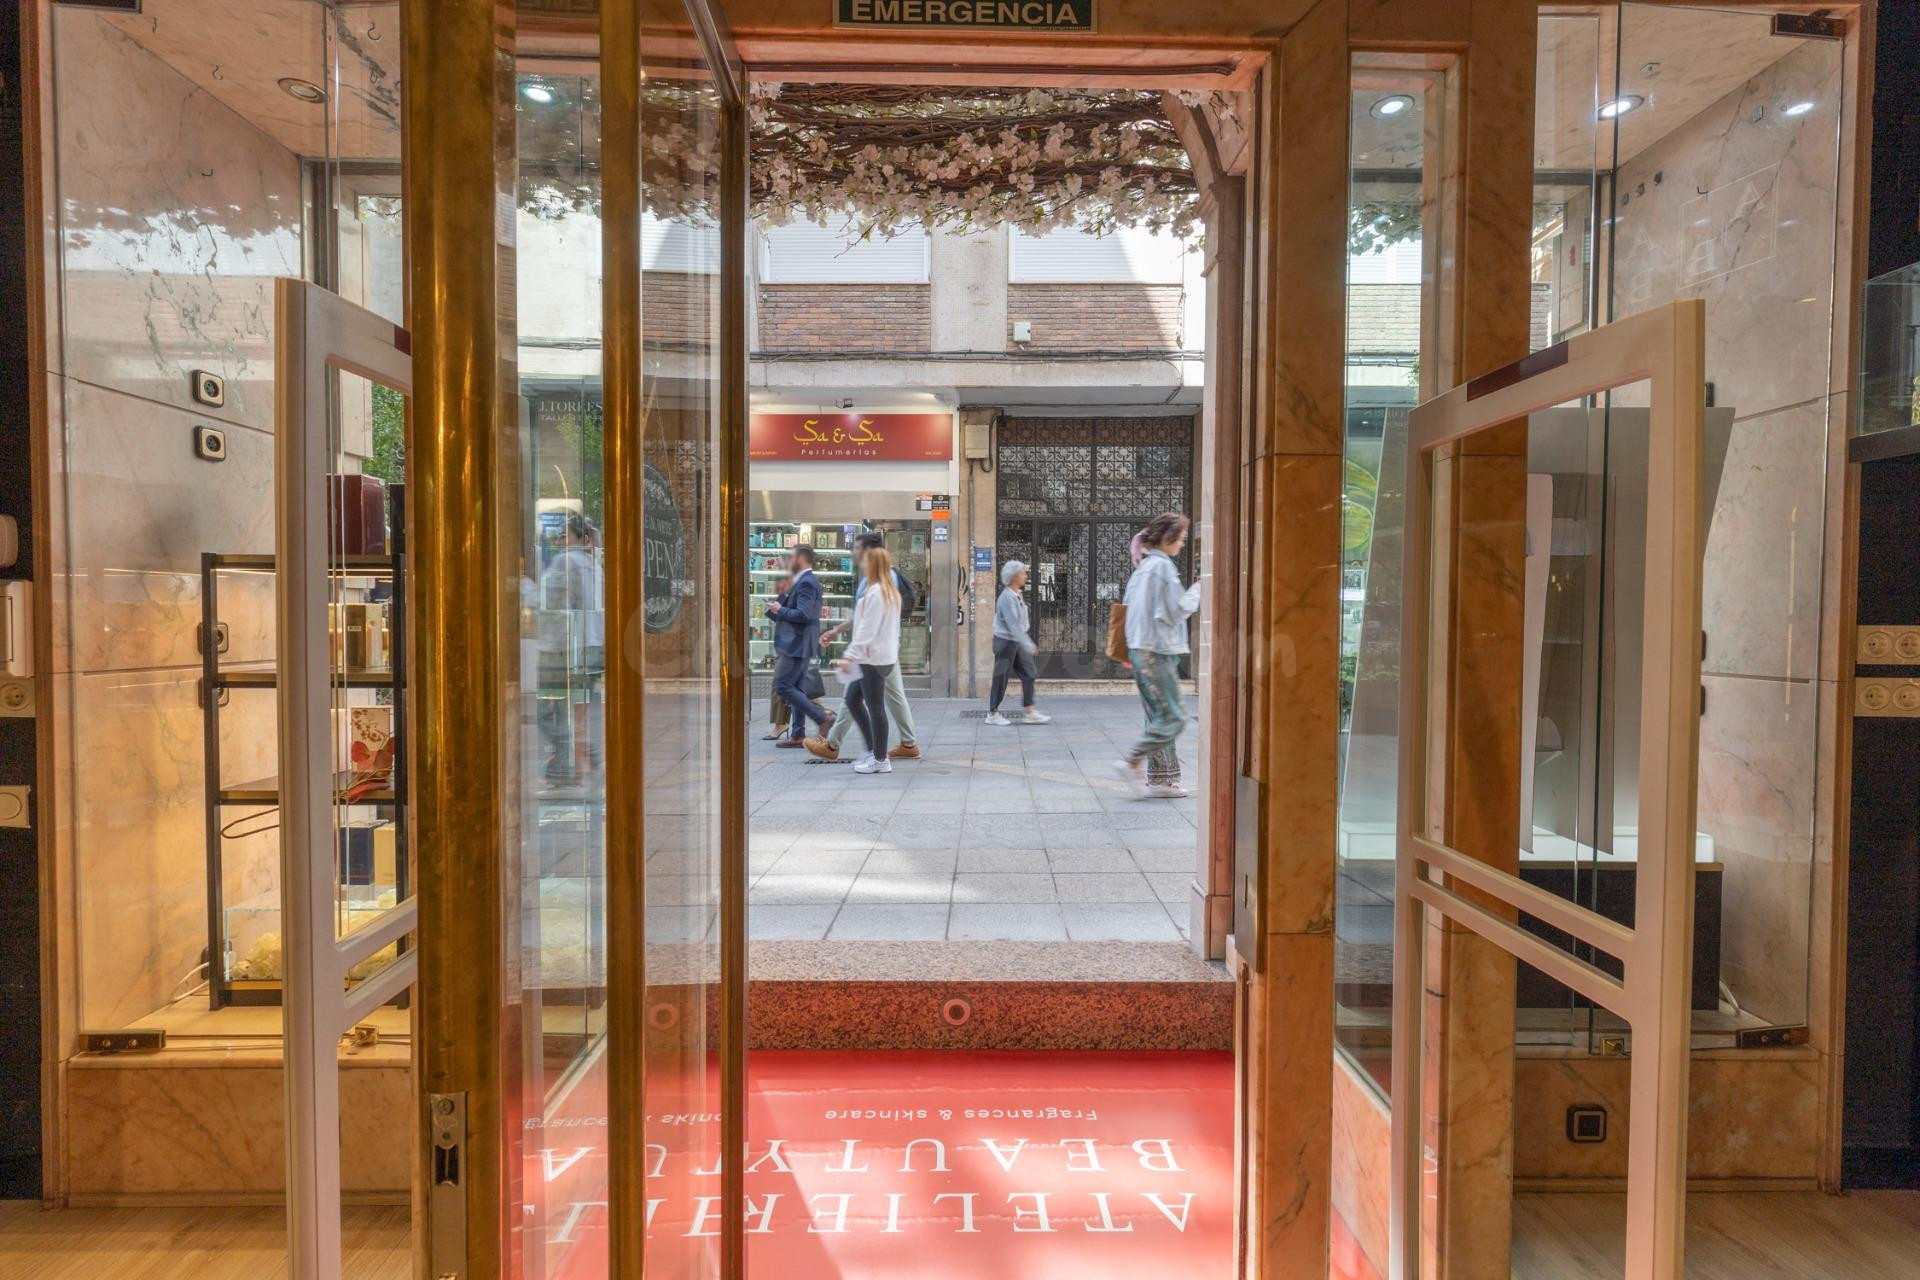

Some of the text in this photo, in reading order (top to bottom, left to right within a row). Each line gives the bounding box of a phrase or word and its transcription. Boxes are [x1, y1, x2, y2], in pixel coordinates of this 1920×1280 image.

[851, 0, 1079, 24] EMERGENCIA
[643, 538, 675, 579] PEN
[824, 1107, 1098, 1121] Fragrances & skincare
[743, 1138, 1187, 1173] BEAUTY
[743, 1192, 1198, 1233] ATELIER
